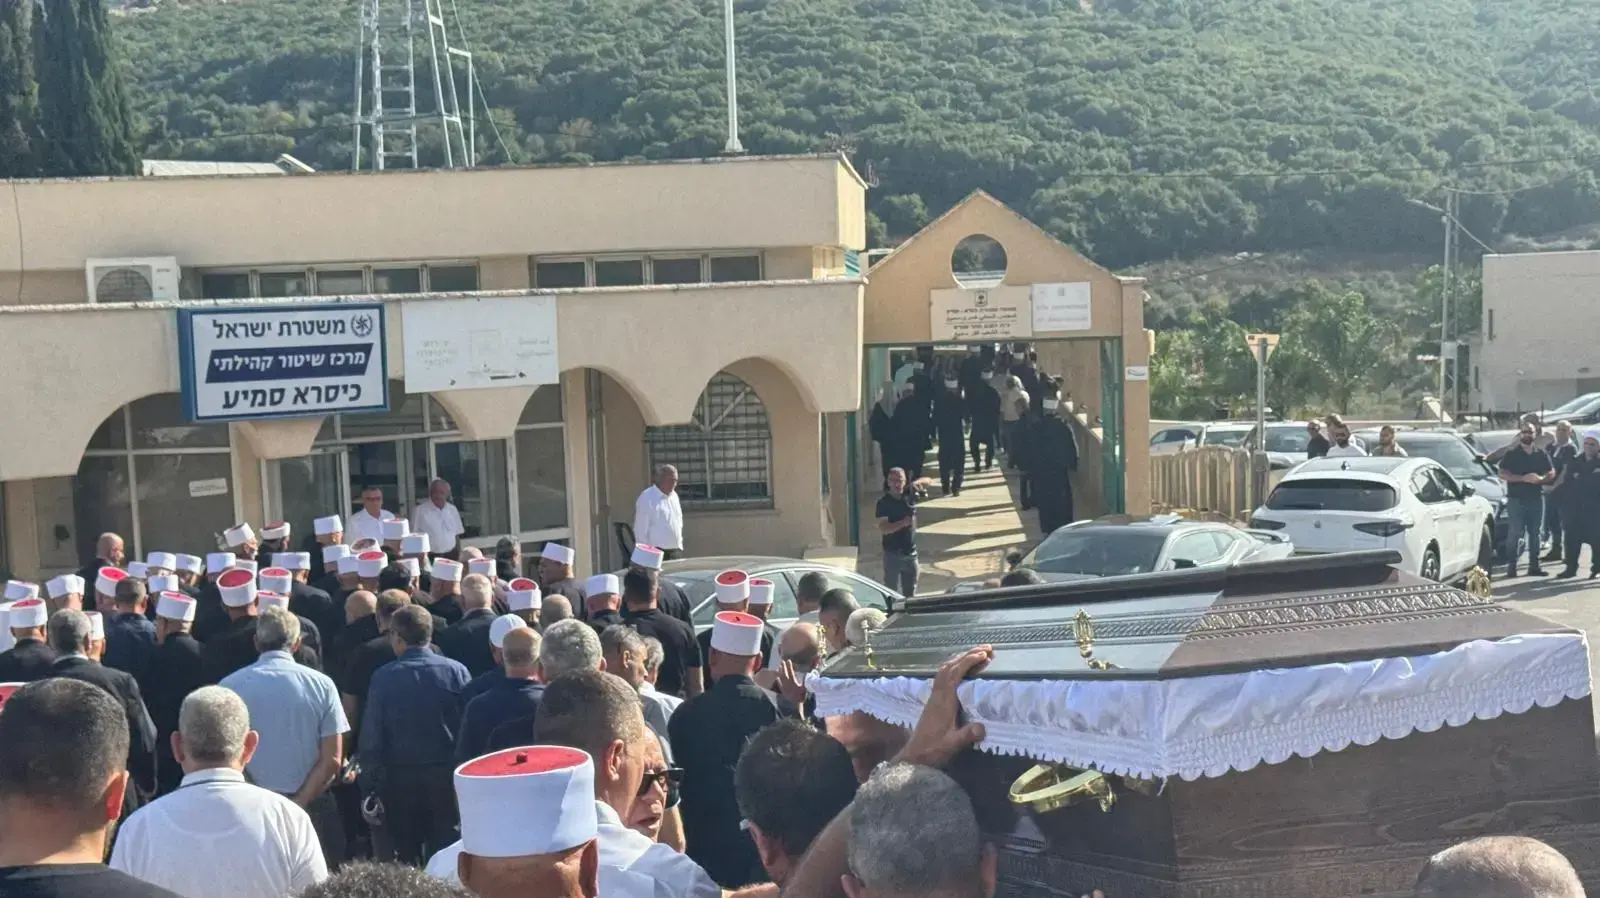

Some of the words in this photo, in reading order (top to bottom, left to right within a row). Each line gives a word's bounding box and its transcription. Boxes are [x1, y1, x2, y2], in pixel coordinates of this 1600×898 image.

[212, 319, 272, 339] ישראל
[277, 319, 346, 337] משטרת
[213, 354, 274, 372] קהילתי
[278, 353, 326, 368] שיטור
[329, 351, 366, 366] מרכז
[222, 387, 285, 409] סמיע
[292, 383, 362, 405] כיסרא
